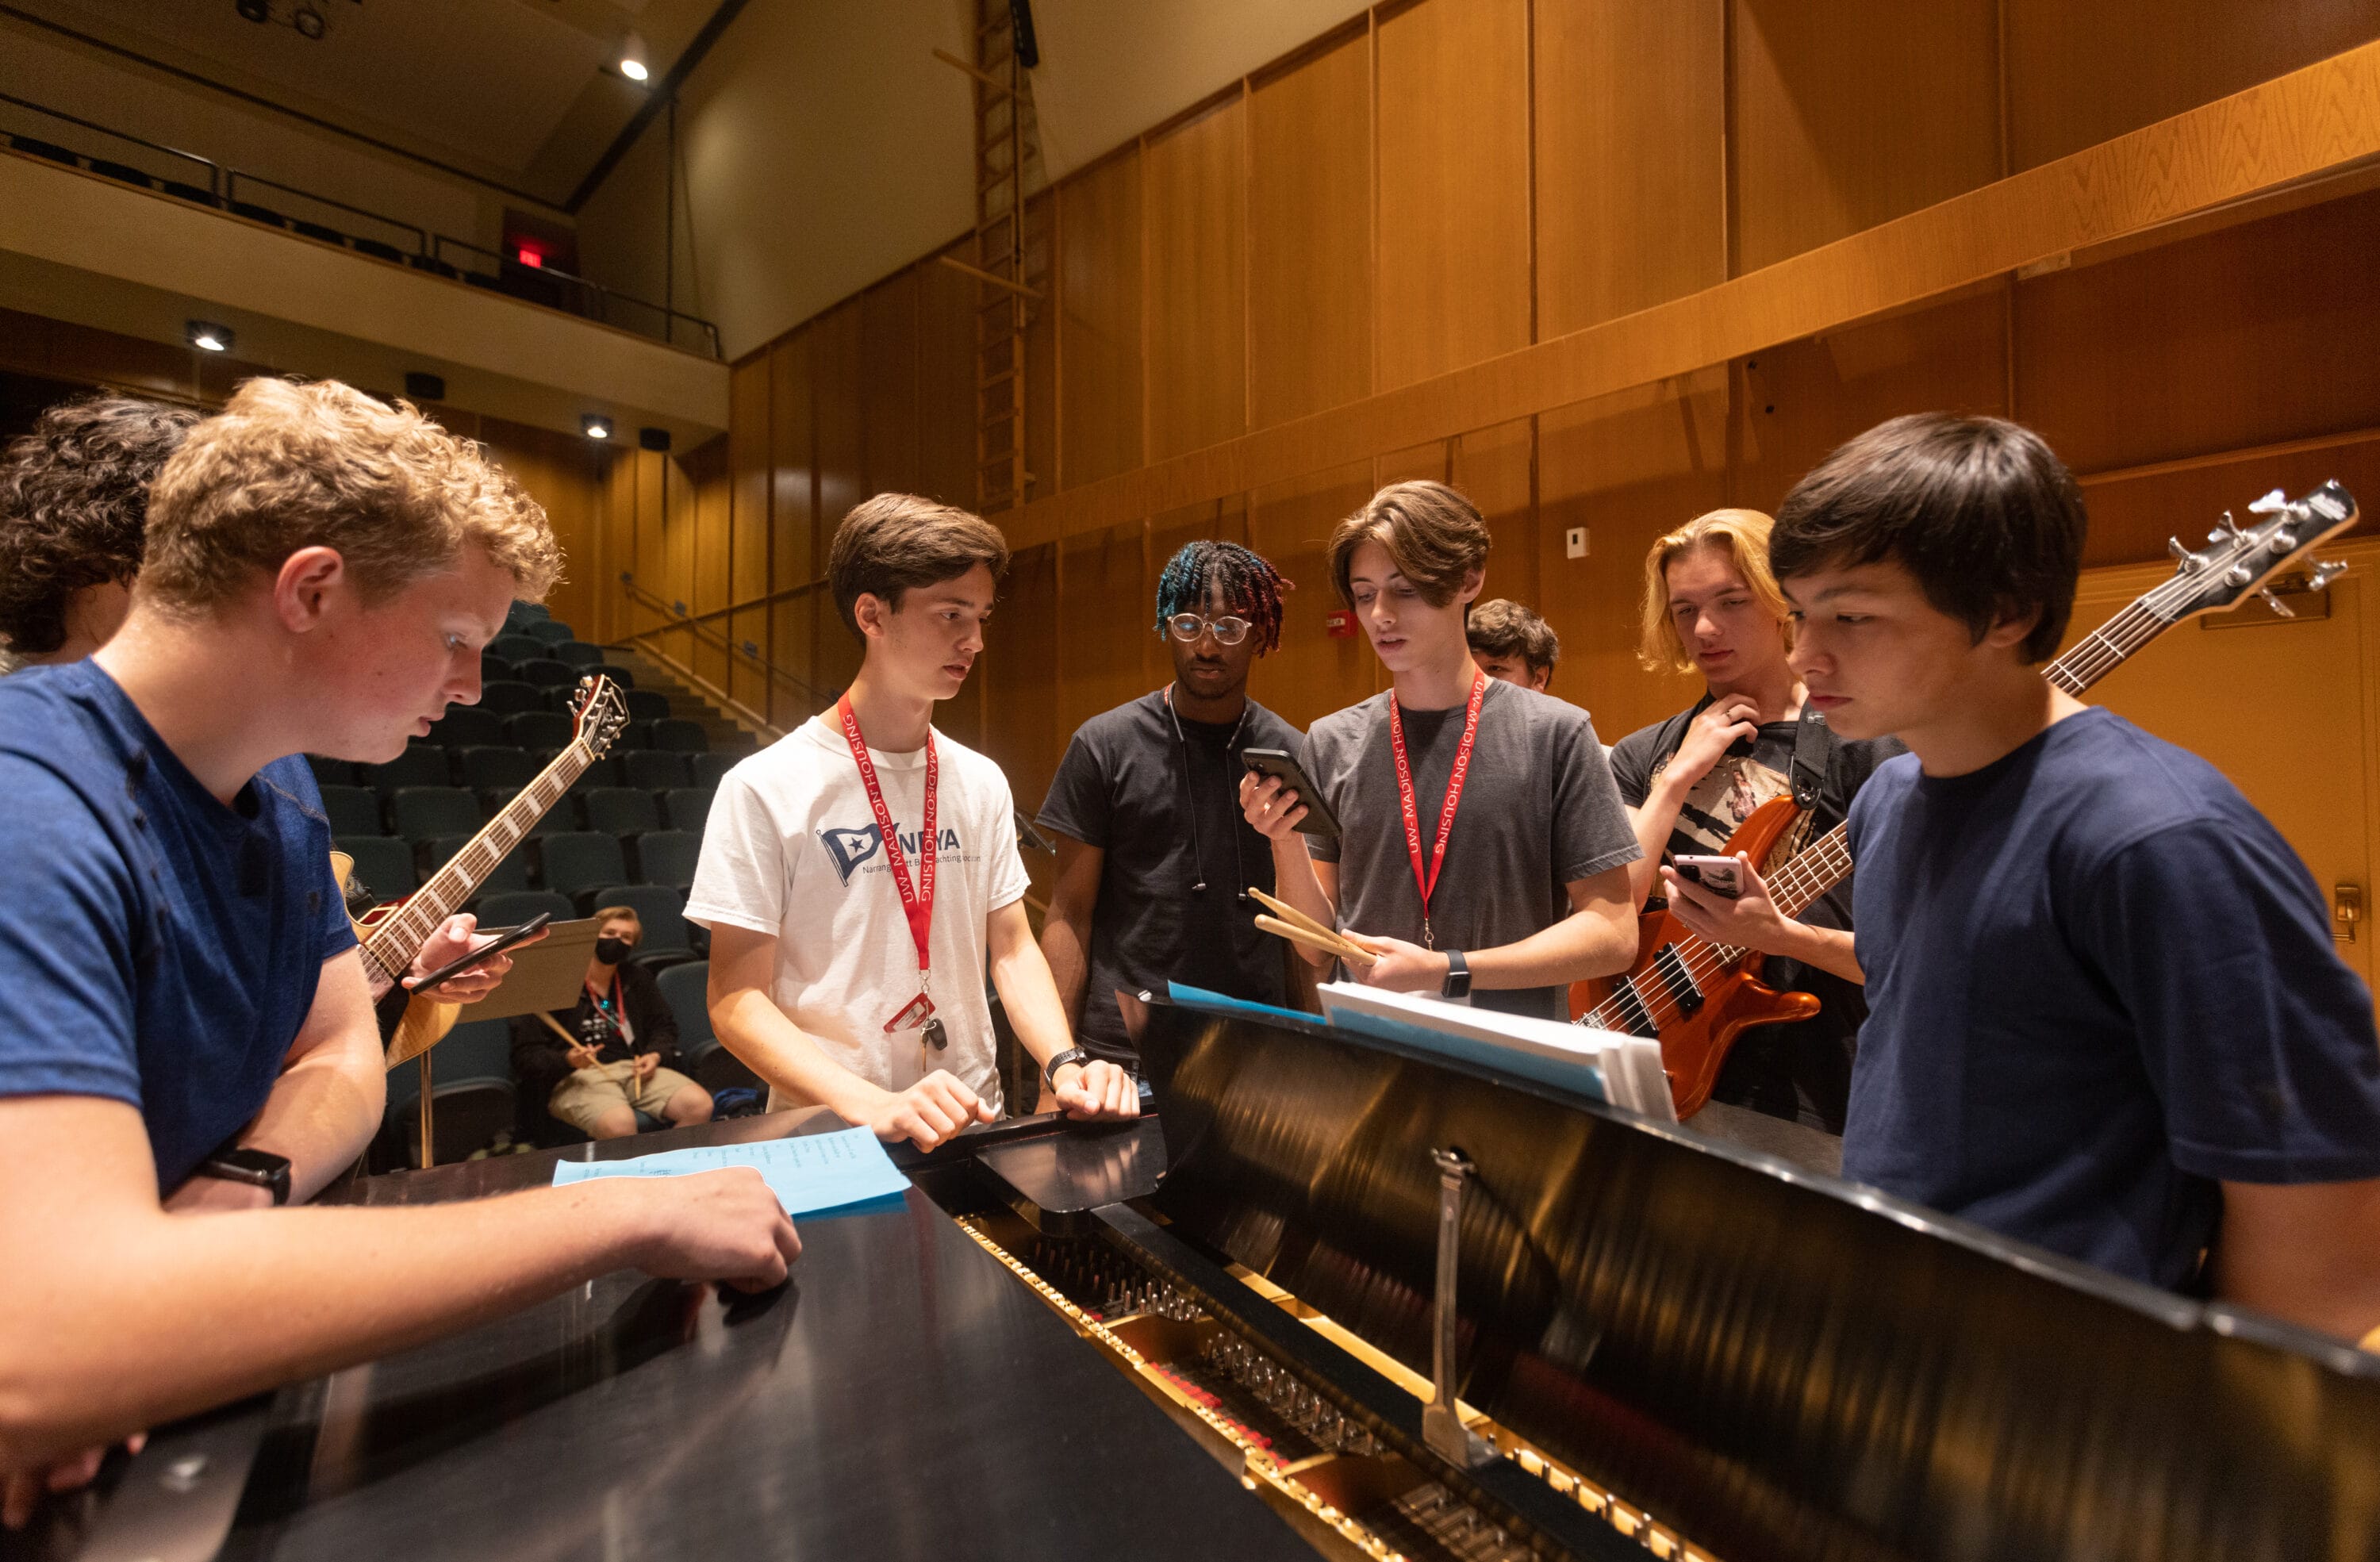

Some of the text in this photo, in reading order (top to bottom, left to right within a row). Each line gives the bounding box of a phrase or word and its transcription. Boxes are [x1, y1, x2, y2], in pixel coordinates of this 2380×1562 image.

[843, 714, 876, 786] HOUSING
[1454, 710, 1477, 777] MADISON
[927, 750, 936, 822] MADISON
[1396, 748, 1415, 818] MADISON
[1435, 783, 1461, 854] HOUSING
[870, 790, 904, 866] MADISON
[921, 828, 935, 901] HOUSING
